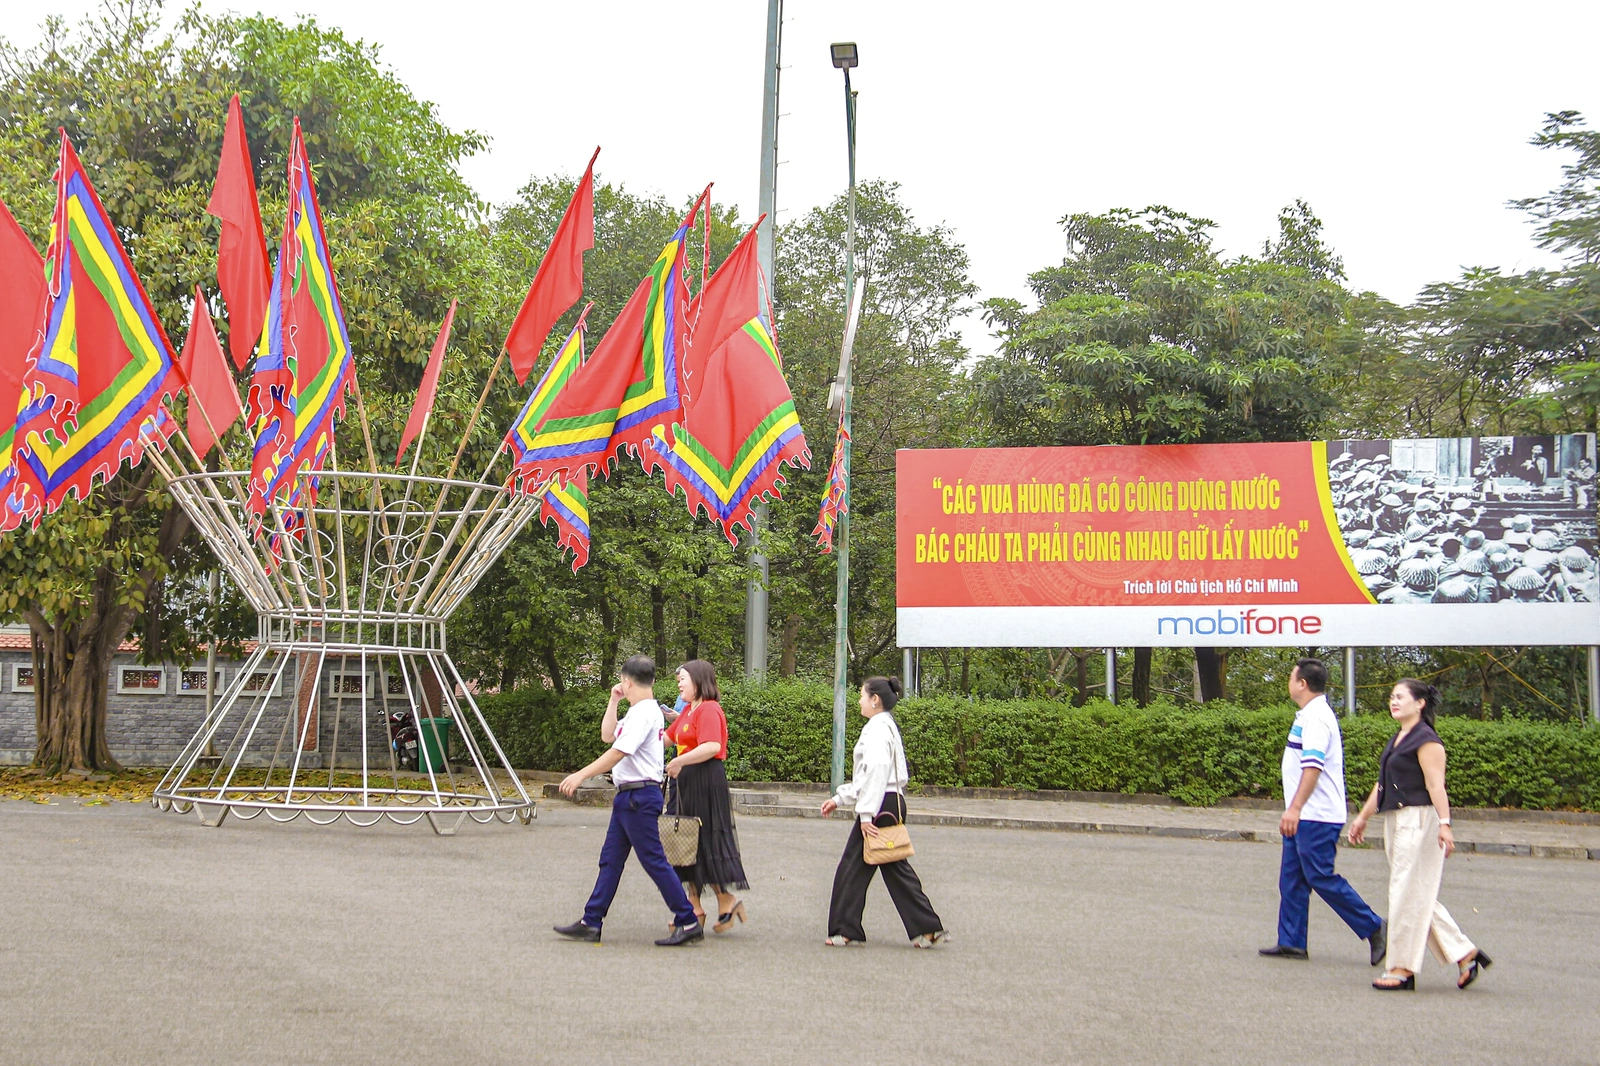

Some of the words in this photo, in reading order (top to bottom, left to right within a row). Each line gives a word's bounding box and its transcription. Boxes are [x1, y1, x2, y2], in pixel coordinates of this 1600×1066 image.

[932, 477, 977, 515] “CÁC
[980, 484, 1014, 514] VUA
[1017, 477, 1065, 513] HÙNG
[1069, 476, 1093, 513] ĐÃ
[1097, 476, 1120, 513] CÓ
[1124, 476, 1173, 512] CÔNG
[1177, 478, 1227, 518] DỰNG
[1231, 473, 1281, 511] NƯỚC
[915, 527, 950, 564] BÁC
[954, 527, 1000, 563] CHÁU
[1004, 532, 1024, 562] TA
[1027, 522, 1068, 562] PHẢI
[1072, 525, 1121, 562] CÙNG
[1125, 530, 1173, 561] NHAU
[1178, 523, 1210, 561] GIỮ
[1211, 519, 1245, 561] LẤY
[1249, 520, 1309, 560] NƯỚC”
[1123, 580, 1154, 594] Trích
[1156, 580, 1172, 594] lời
[1174, 578, 1198, 594] Chủ
[1200, 579, 1224, 597] tịch
[1226, 577, 1243, 593] Hồ
[1244, 579, 1265, 593] Chí
[1267, 578, 1298, 593] Minh
[1157, 608, 1322, 635] mobifone
